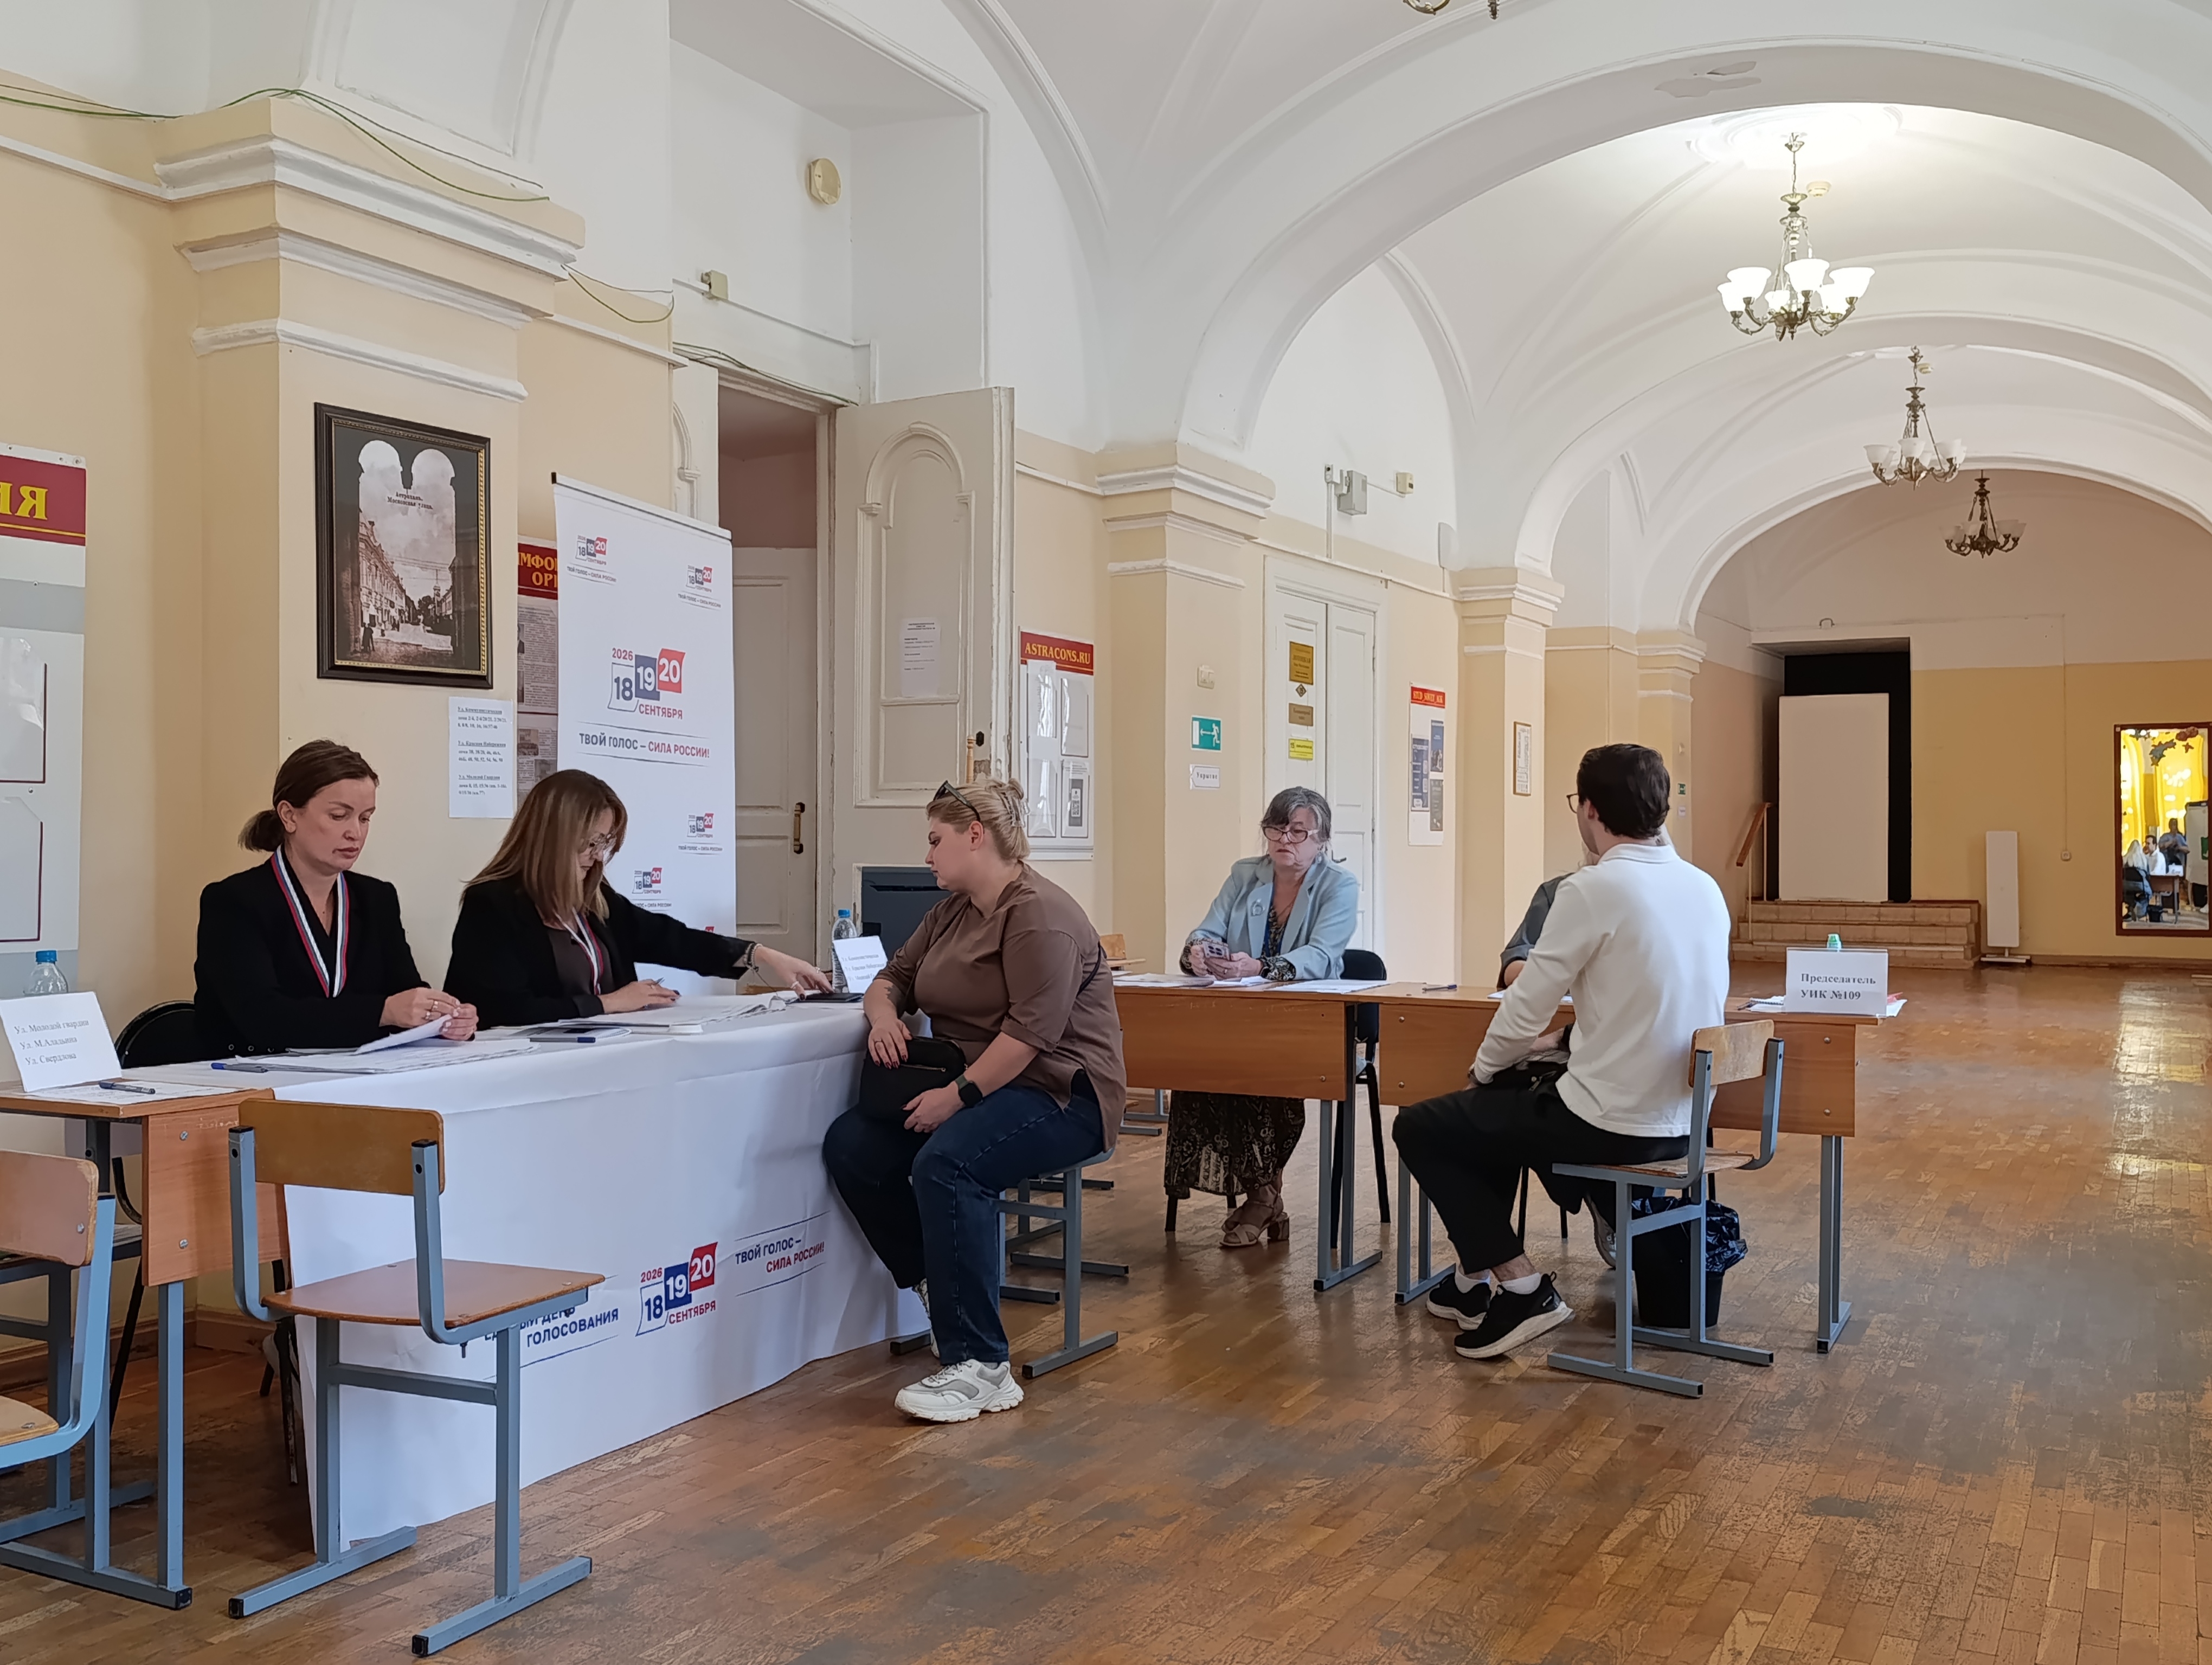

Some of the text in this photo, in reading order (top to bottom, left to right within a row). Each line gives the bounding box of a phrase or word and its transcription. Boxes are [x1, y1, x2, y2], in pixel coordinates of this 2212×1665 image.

[387, 496, 416, 506] Московская
[578, 541, 606, 557] 18 19 20
[518, 552, 557, 571] МФО
[689, 570, 711, 584] 18 19 20
[612, 647, 633, 661] 2026
[1025, 642, 1090, 664] ASTRACONS.RU
[614, 657, 680, 701] 18 19 20
[639, 703, 683, 720] СЕНТЯБРЯ
[579, 732, 606, 747] ТВОЙ
[608, 736, 638, 750] ГОЛОС
[648, 741, 672, 754] СИЛА
[674, 744, 710, 758] РОССИИ!
[689, 817, 712, 834] 18 19 20
[635, 871, 660, 890] 18 19 20
[1801, 973, 1876, 984] Председатель
[1801, 989, 1861, 1000] УИК №109
[14, 1020, 89, 1034] Ул. Молодой гвардии
[20, 1037, 78, 1050] Ул. М.Аладьина
[25, 1053, 77, 1065] Ул. Свердлова
[735, 1244, 761, 1264] ТВОЙ
[763, 1237, 793, 1256] ГОЛОС
[766, 1241, 825, 1273] СИЛА РОССИИ!
[640, 1267, 662, 1283] 2026
[645, 1253, 714, 1322] 18 19 20
[668, 1300, 716, 1325] СЕНТЯБРЯ
[527, 1308, 619, 1347] ГОЛОСОВАНИЯ
